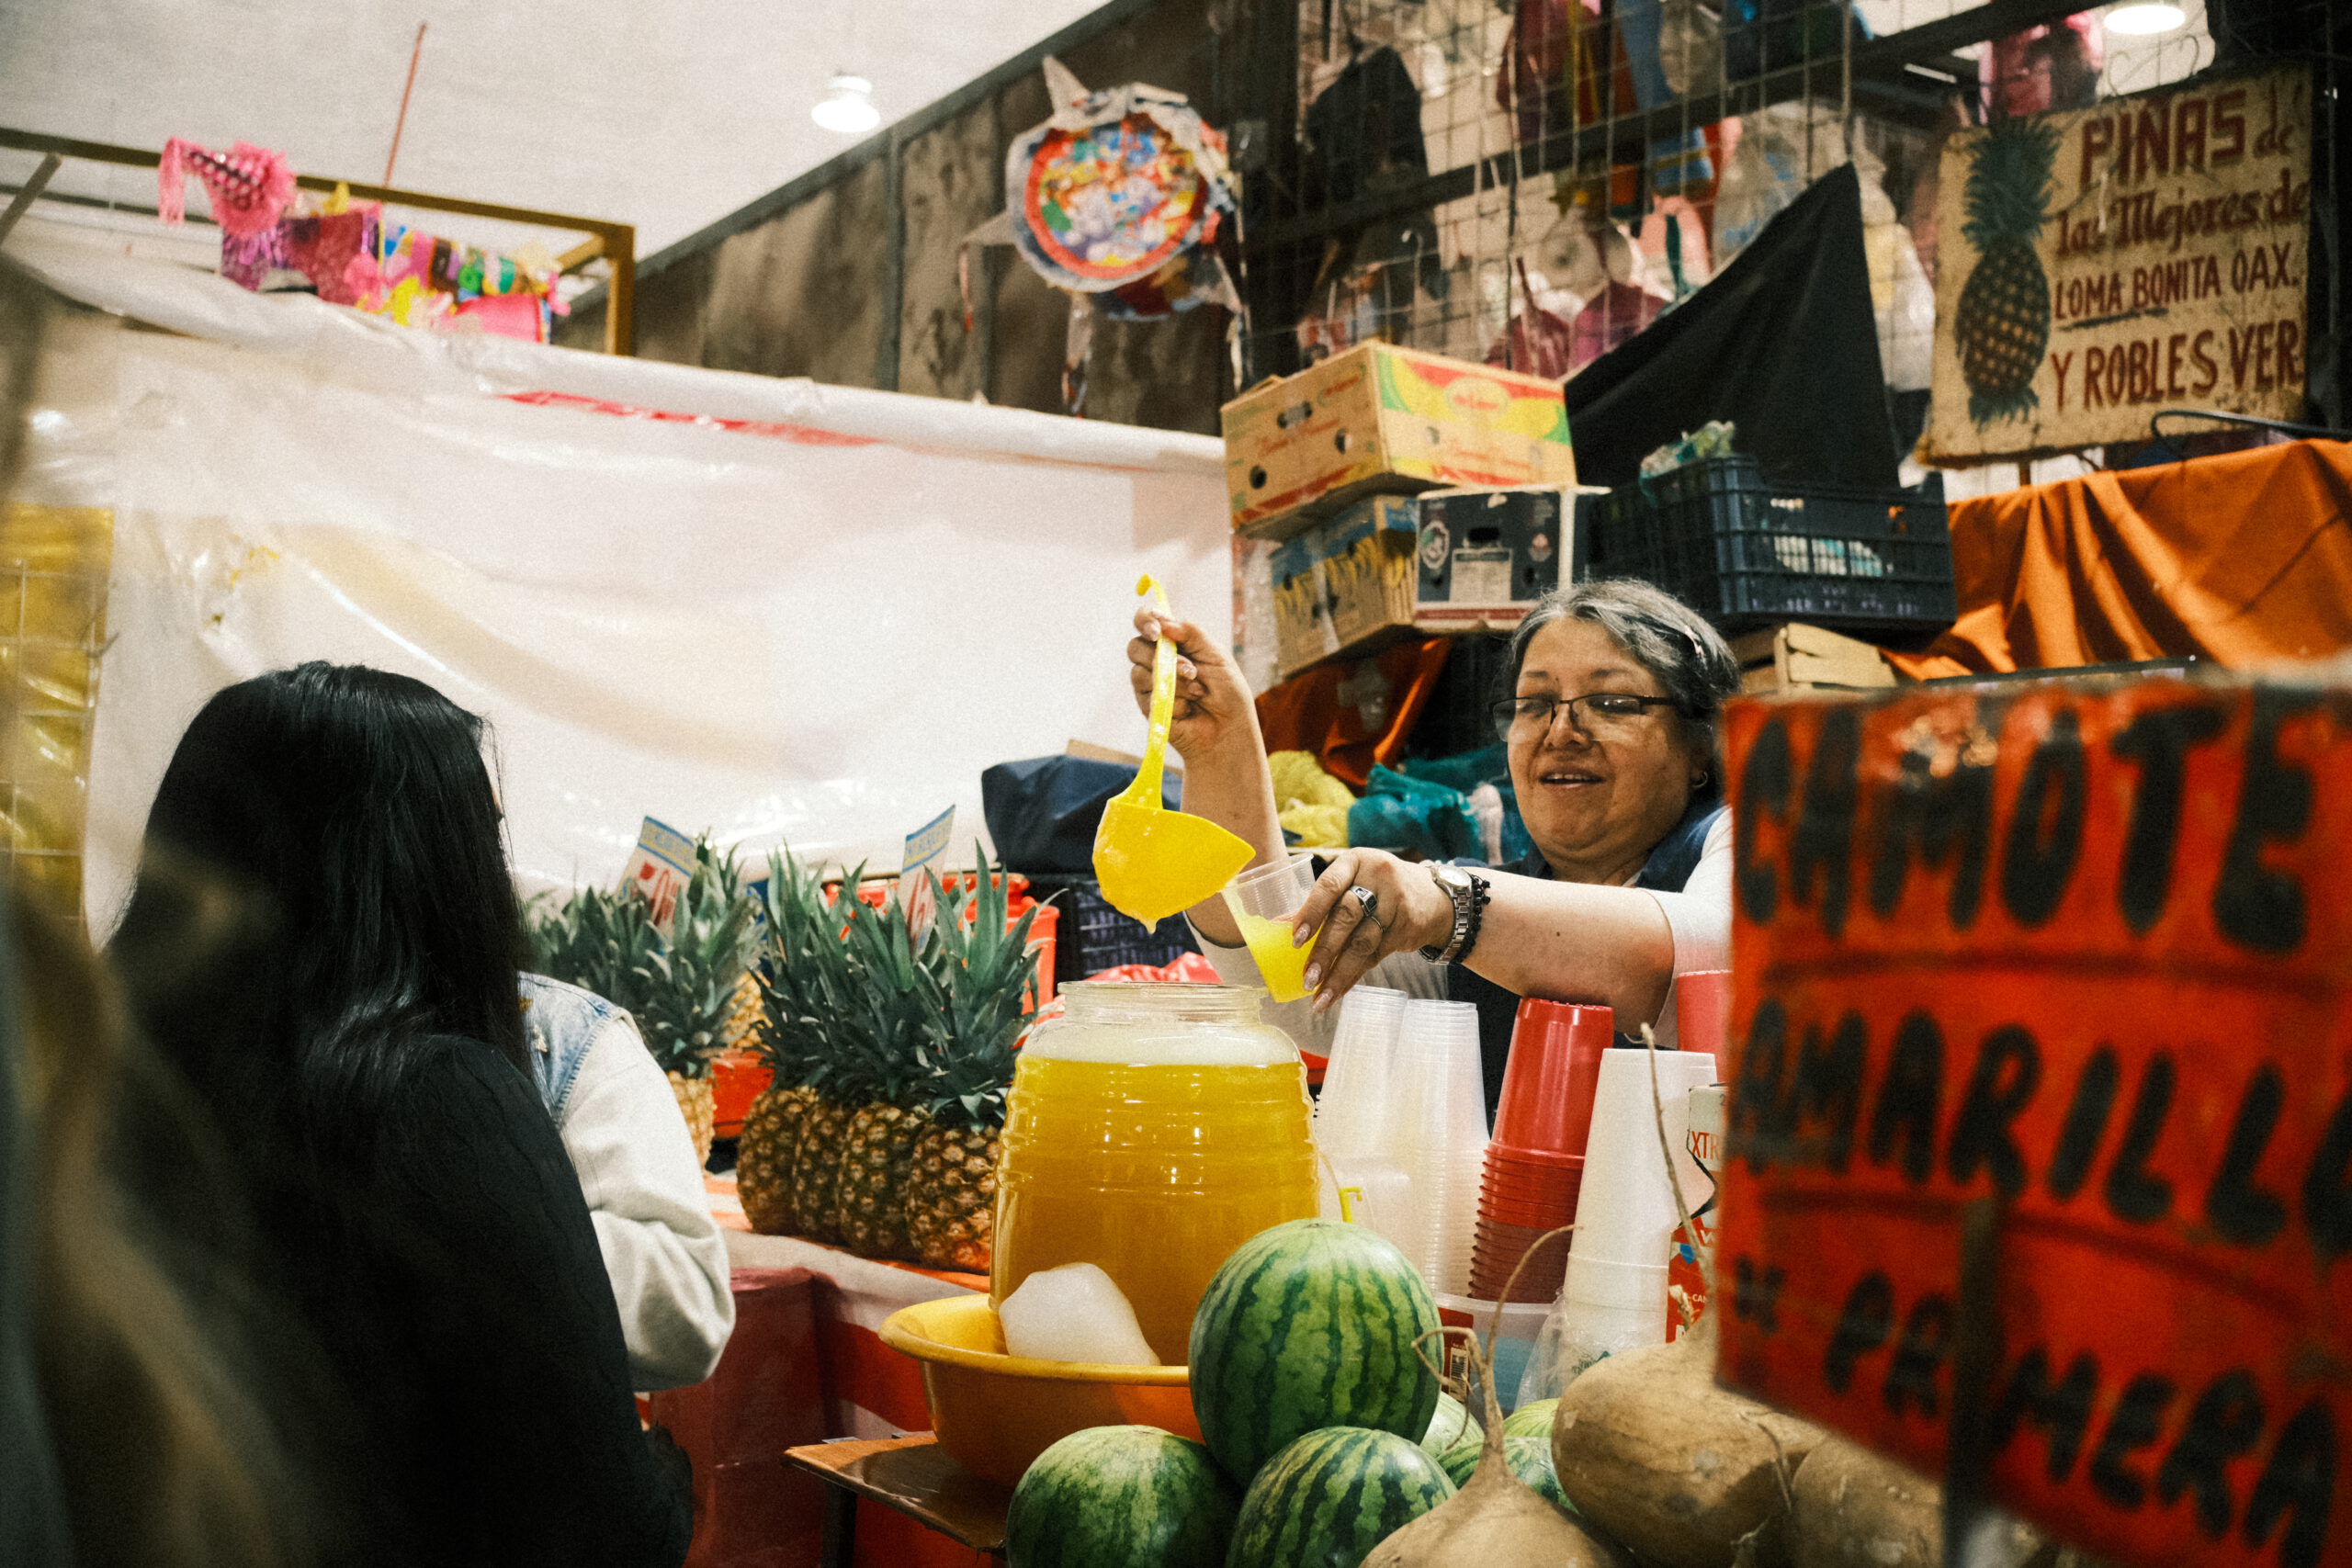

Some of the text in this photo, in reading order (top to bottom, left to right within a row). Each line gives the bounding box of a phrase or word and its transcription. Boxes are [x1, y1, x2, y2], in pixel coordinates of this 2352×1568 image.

[2110, 187, 2262, 254] Mejores
[2267, 168, 2309, 225] de
[2055, 272, 2124, 321] LOMA
[2132, 254, 2222, 309] BONITA
[2051, 351, 2074, 413] Y
[2083, 329, 2219, 411] ROBLES
[1735, 687, 2320, 954] CAMOTE
[1824, 1269, 2338, 1568] PRMERA
